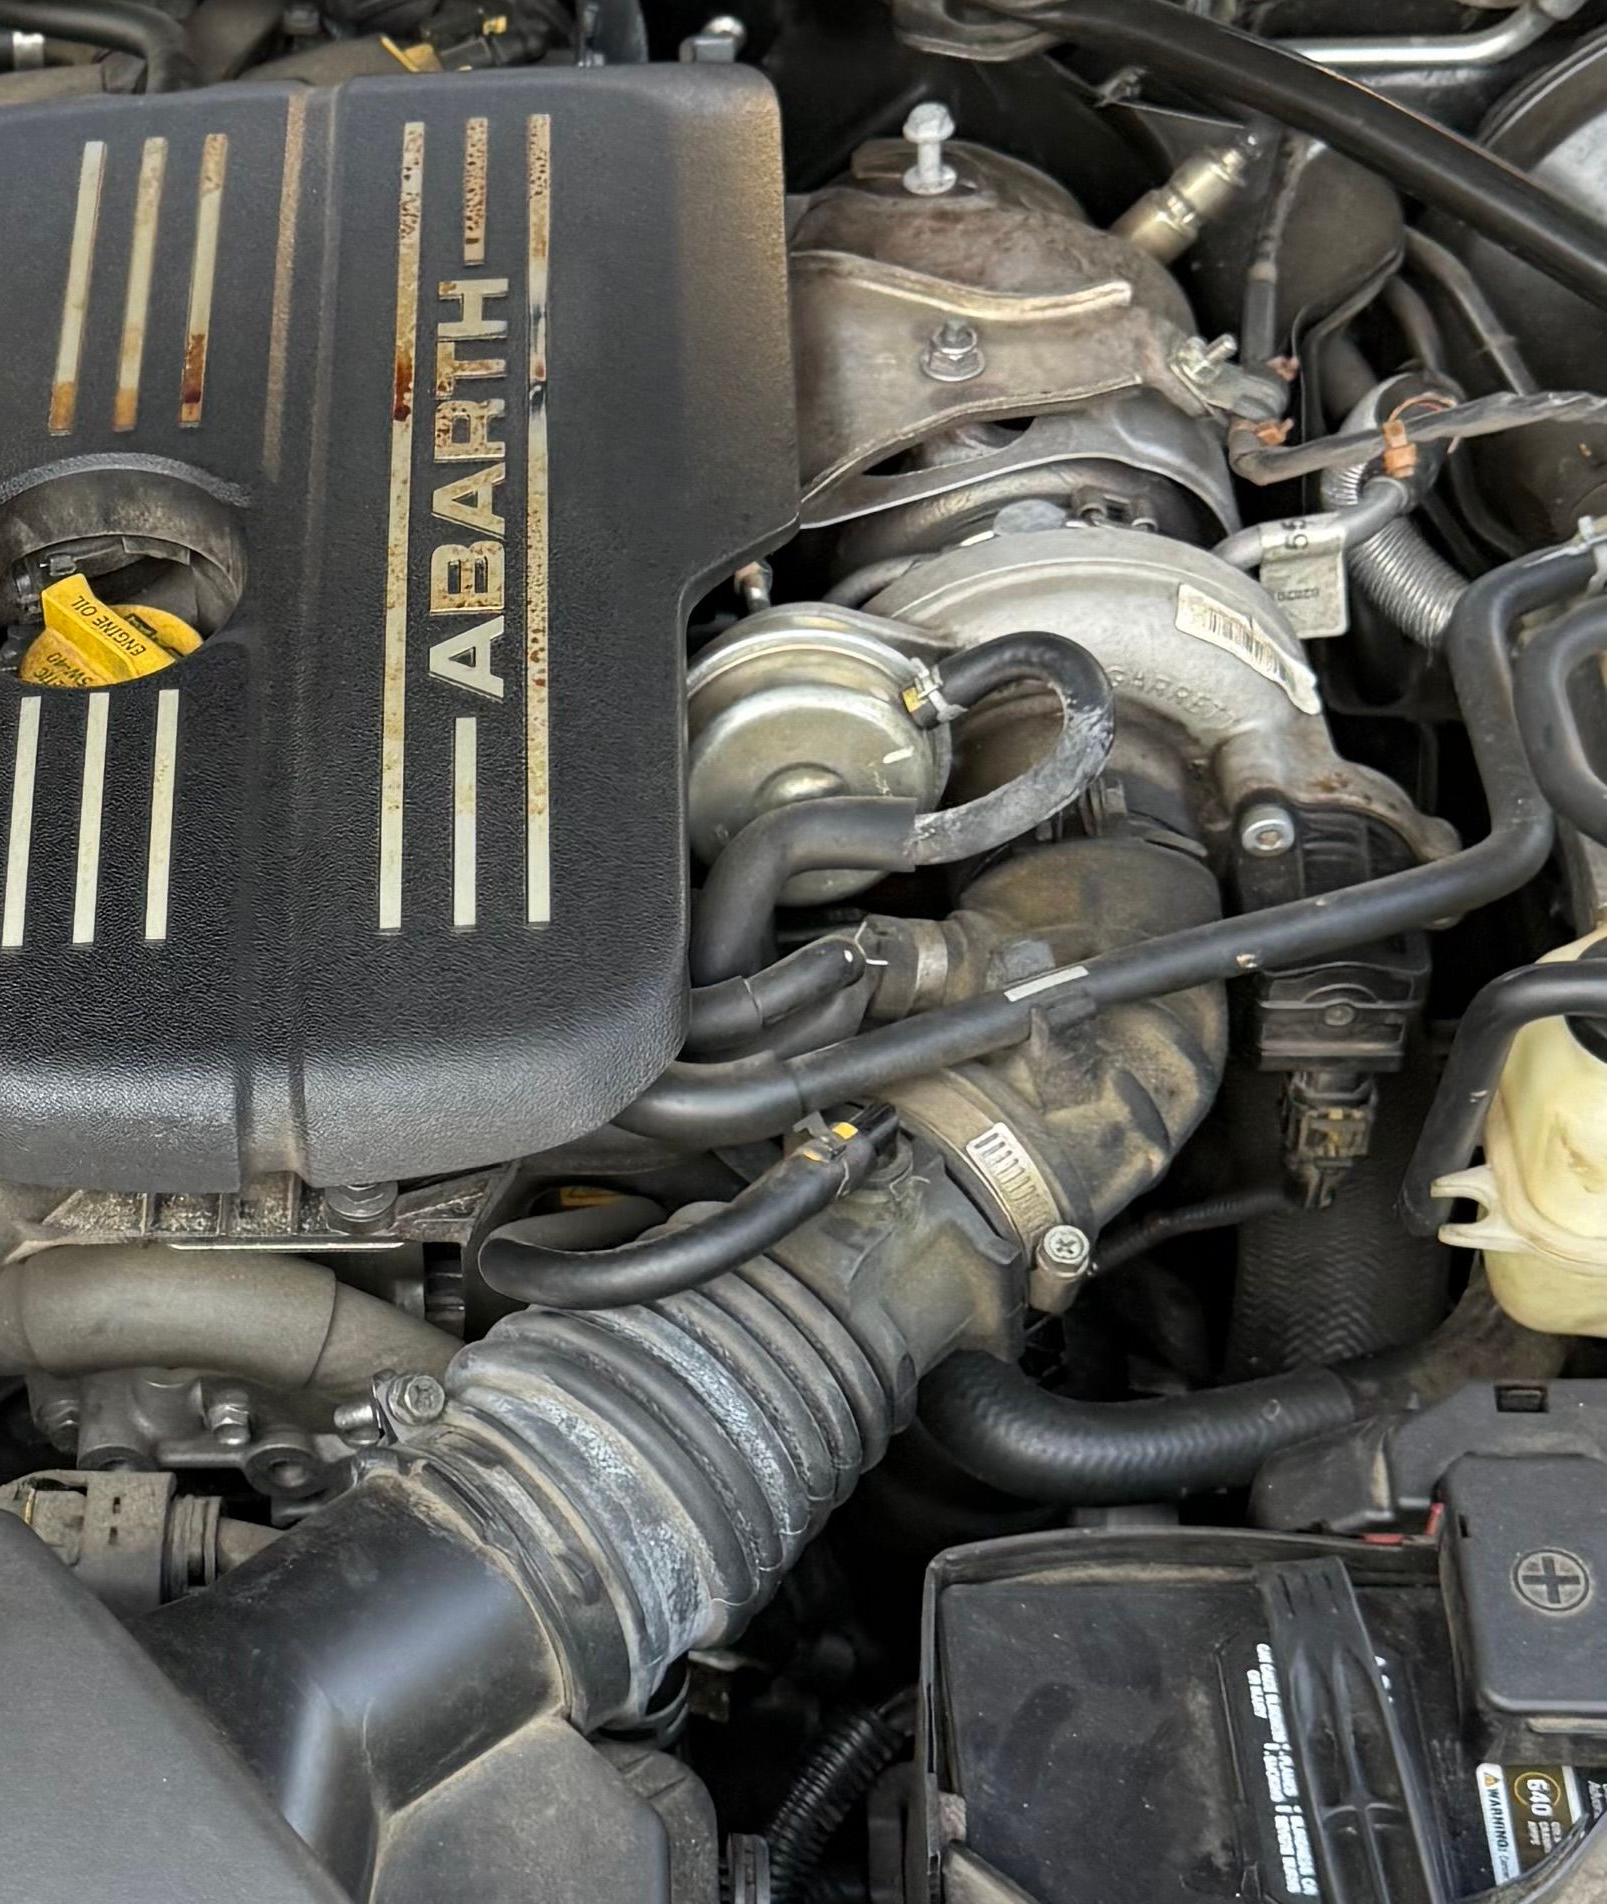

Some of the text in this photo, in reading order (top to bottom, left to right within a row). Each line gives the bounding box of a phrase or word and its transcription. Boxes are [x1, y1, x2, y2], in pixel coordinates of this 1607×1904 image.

[428, 277, 509, 702] ABARTH
[71, 595, 97, 617] OIL
[92, 615, 147, 657] ENGINE
[46, 652, 94, 686] 5W-40
[1526, 1779, 1553, 1816] 640
